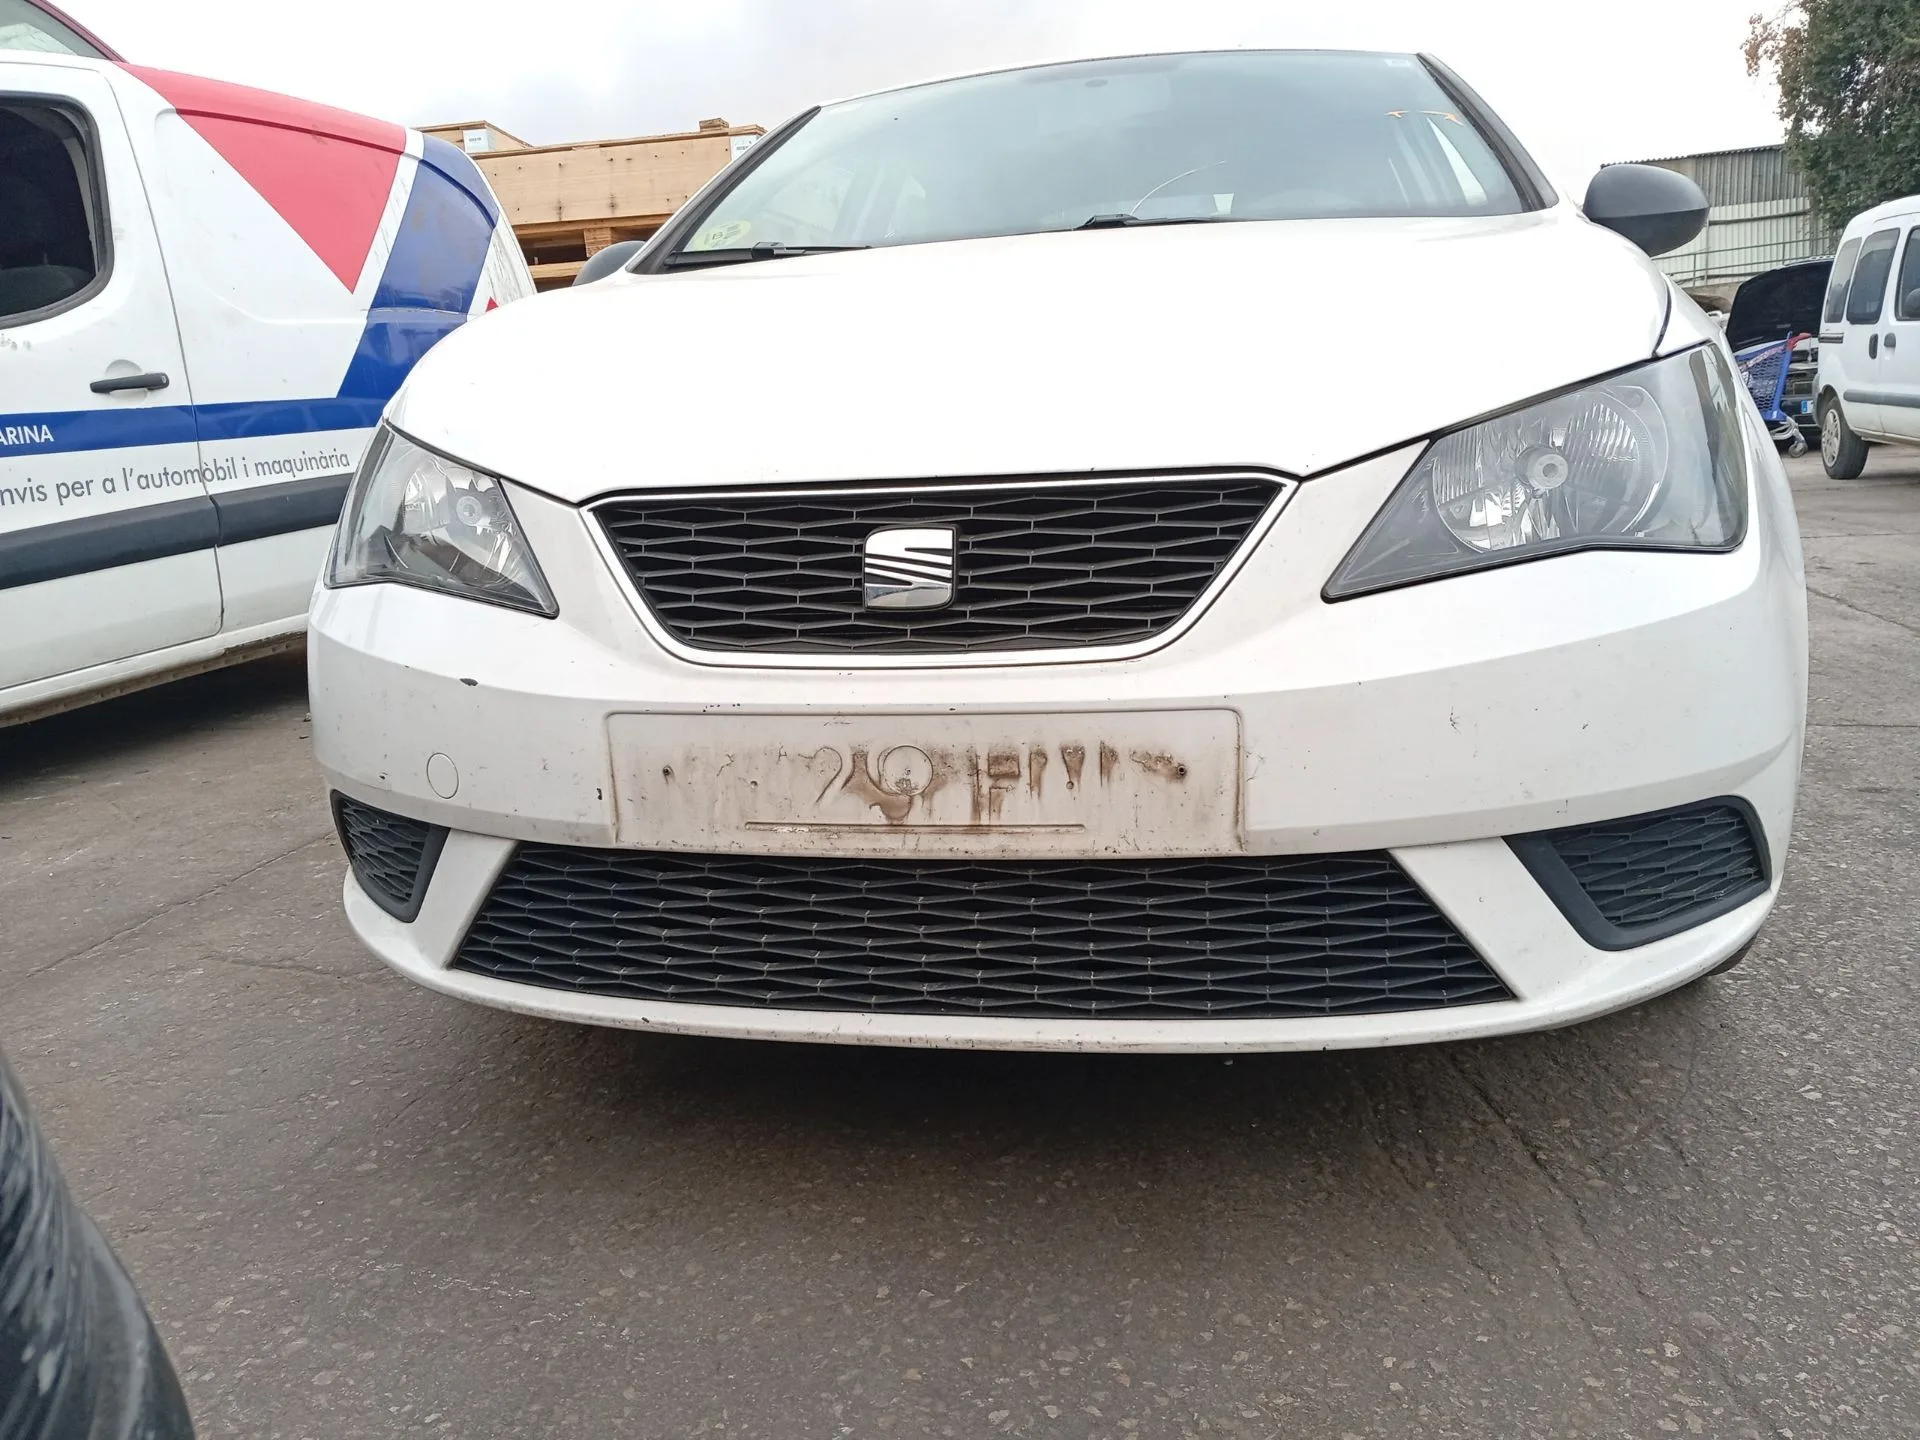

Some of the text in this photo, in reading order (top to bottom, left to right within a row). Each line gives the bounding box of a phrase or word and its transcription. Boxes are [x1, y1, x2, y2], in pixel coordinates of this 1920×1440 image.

[56, 479, 94, 506] per
[102, 477, 116, 494] a
[242, 456, 249, 478] i
[254, 447, 350, 478] maquinària
